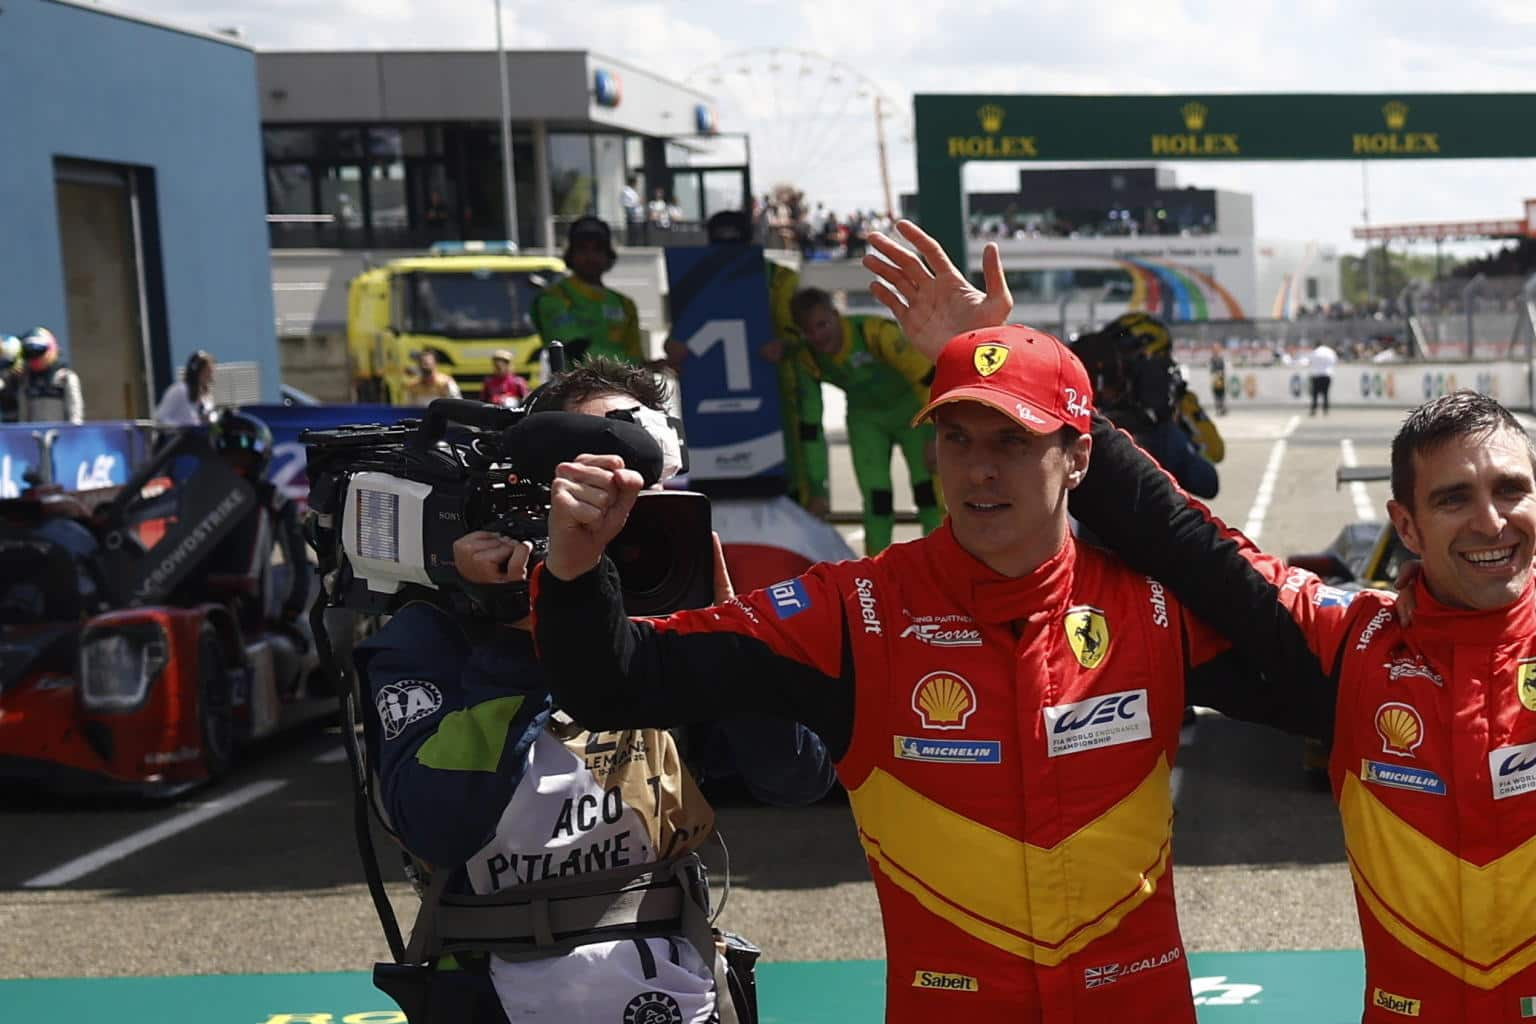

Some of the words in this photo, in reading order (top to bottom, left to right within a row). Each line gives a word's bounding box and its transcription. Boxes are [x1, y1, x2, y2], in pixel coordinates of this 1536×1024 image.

[948, 136, 1037, 157] ROLEX
[1152, 134, 1239, 155] ROLEX
[1353, 132, 1440, 152] ROLEX
[686, 320, 752, 391] 1
[439, 511, 461, 521] SONY
[855, 577, 882, 634] Sabelt
[1356, 607, 1393, 651] Sabelt
[1053, 694, 1141, 735] WEC
[1053, 737, 1066, 746] FIA
[1066, 731, 1094, 743] WORLD
[1095, 723, 1141, 738] ENDURANCE
[1053, 735, 1112, 753] CHAMPIONSHIP
[921, 746, 991, 757] MICHELIN
[1378, 770, 1439, 788] MICHELIN
[1500, 780, 1512, 788] FIA
[551, 785, 622, 838] ACO
[486, 830, 630, 891] PITLANE
[1119, 947, 1181, 977] J.CALADO
[920, 972, 972, 990] Sabelt
[1376, 989, 1415, 1015] Sabelt
